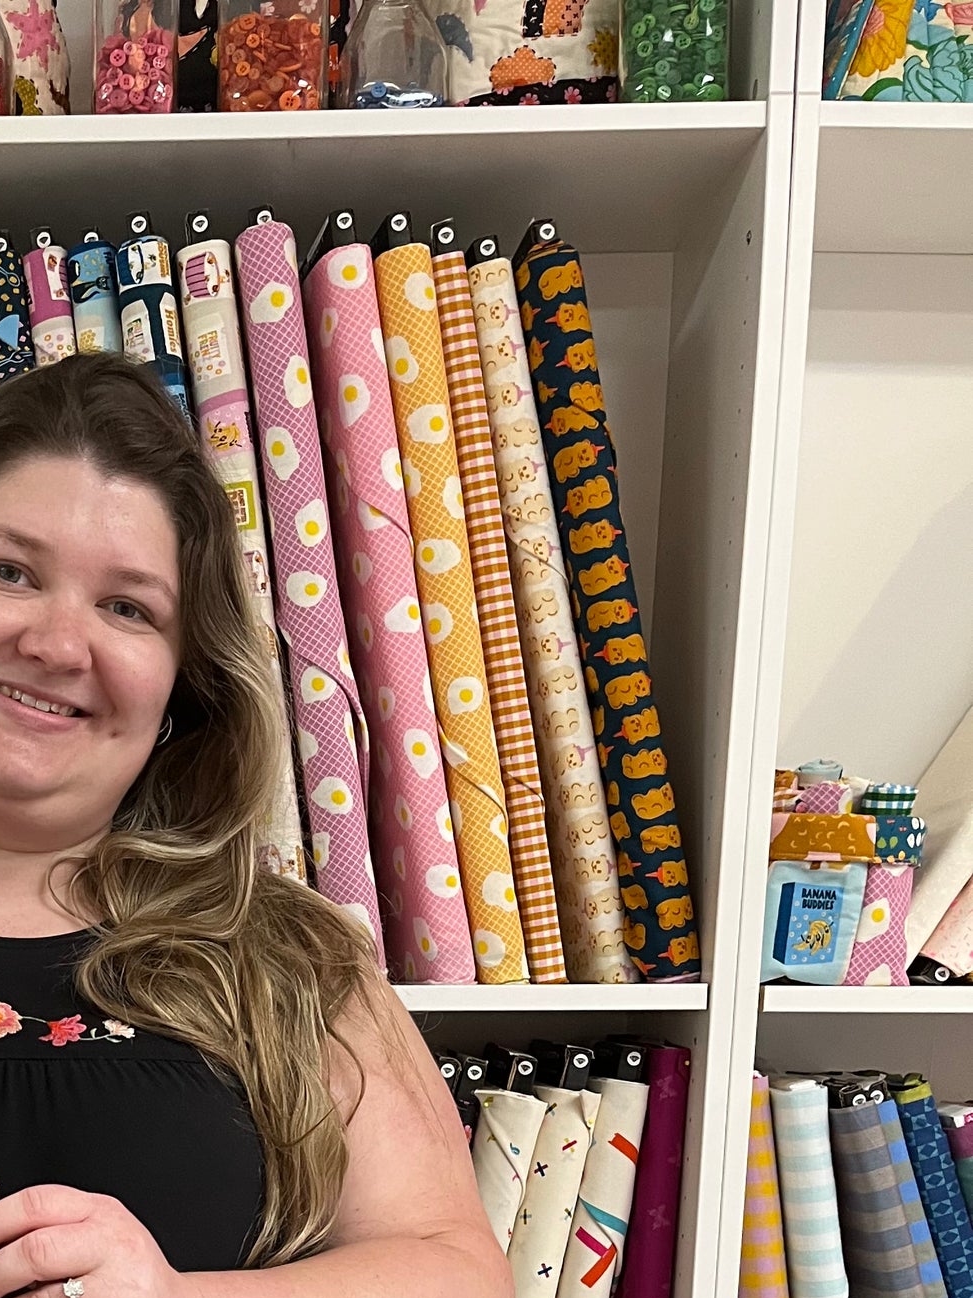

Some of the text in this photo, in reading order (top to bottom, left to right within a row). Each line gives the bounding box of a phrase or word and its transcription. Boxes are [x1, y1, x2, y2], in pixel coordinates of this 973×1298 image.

[165, 309, 178, 353] Homies
[208, 330, 221, 358] FRUITY
[802, 888, 837, 900] BANANA
[802, 899, 834, 910] BUDDIES
